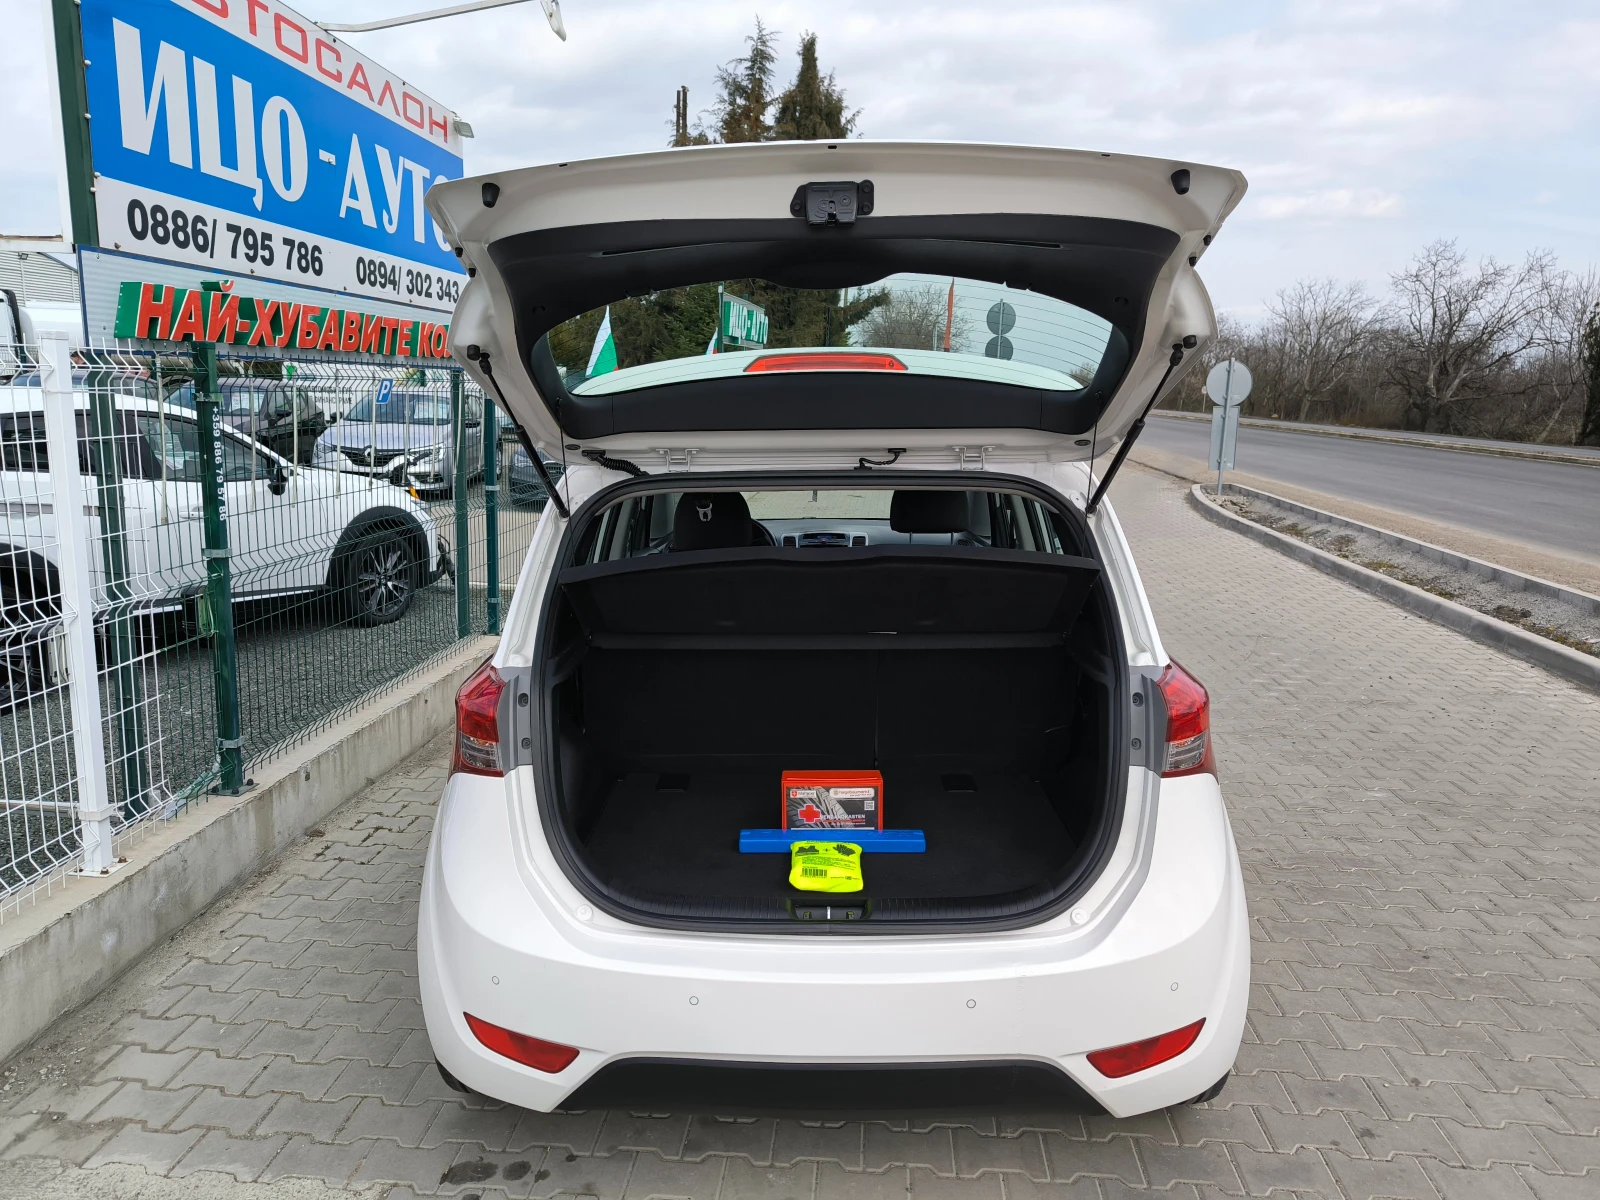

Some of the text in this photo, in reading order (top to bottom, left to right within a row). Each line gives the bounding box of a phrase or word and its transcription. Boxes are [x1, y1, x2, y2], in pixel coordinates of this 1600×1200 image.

[127, 198, 324, 277] 0886/ 795 786
[135, 279, 452, 359] НАЙ-ХУБАВИТЕ КО
[356, 256, 460, 304] 0894/ 302 343
[379, 381, 390, 401] P
[212, 405, 228, 522] +359 886 79 57 86
